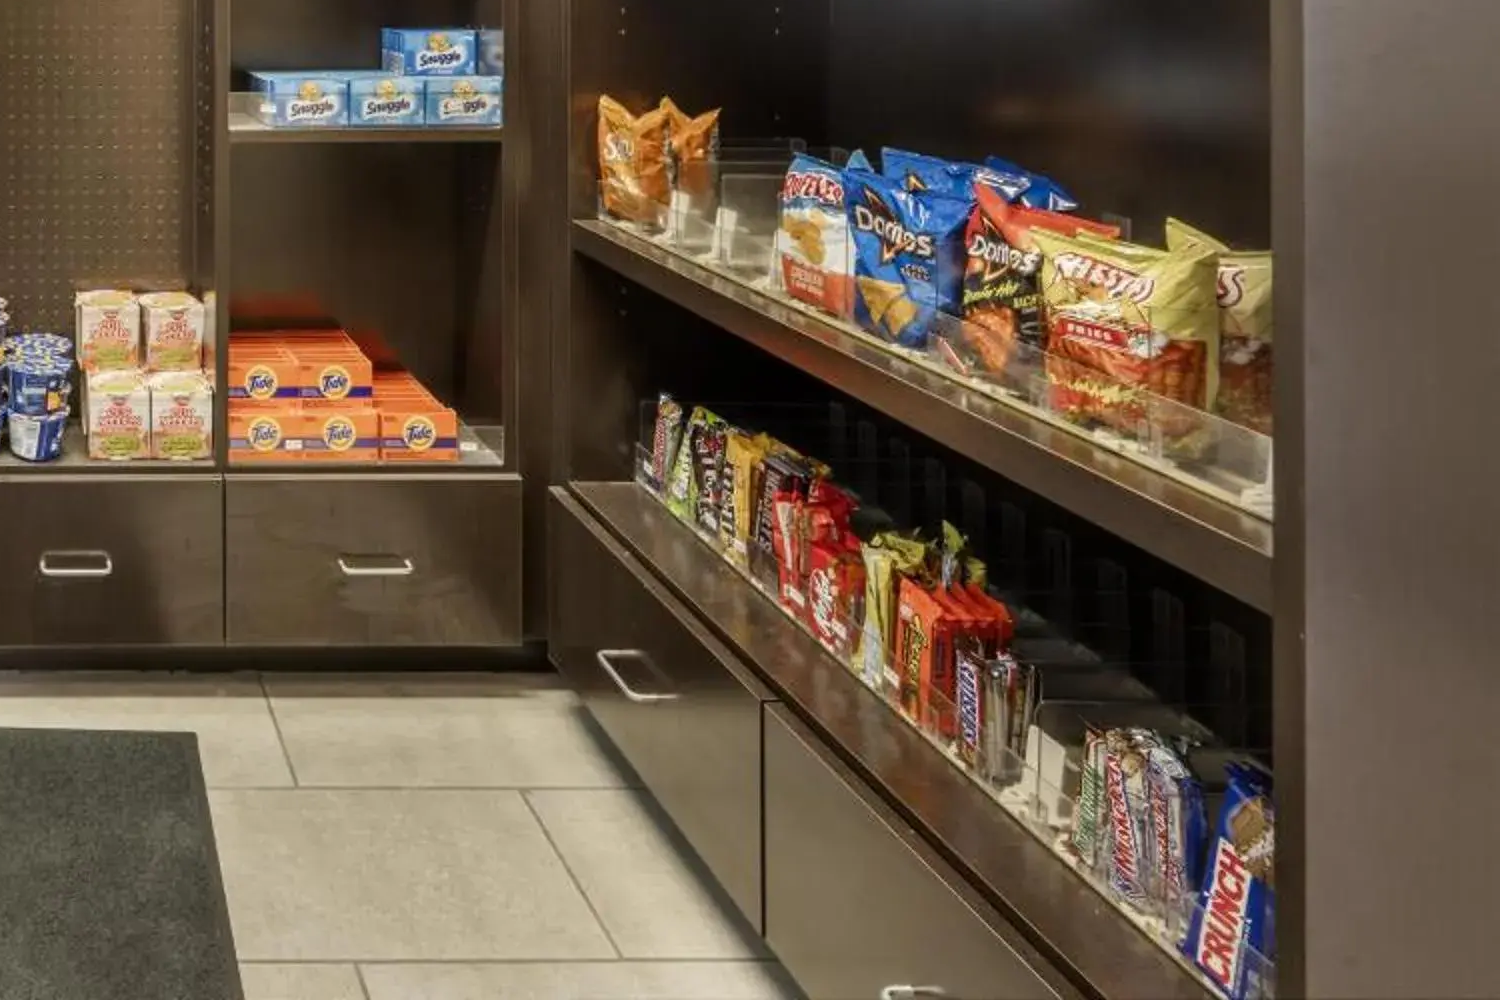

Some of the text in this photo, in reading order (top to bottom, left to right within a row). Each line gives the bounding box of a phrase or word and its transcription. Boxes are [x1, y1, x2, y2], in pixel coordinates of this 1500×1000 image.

[418, 50, 463, 68] Snuggle
[290, 100, 336, 117] Snuggle
[367, 98, 411, 116] Snuggle
[1200, 846, 1249, 985] CRUNCH
